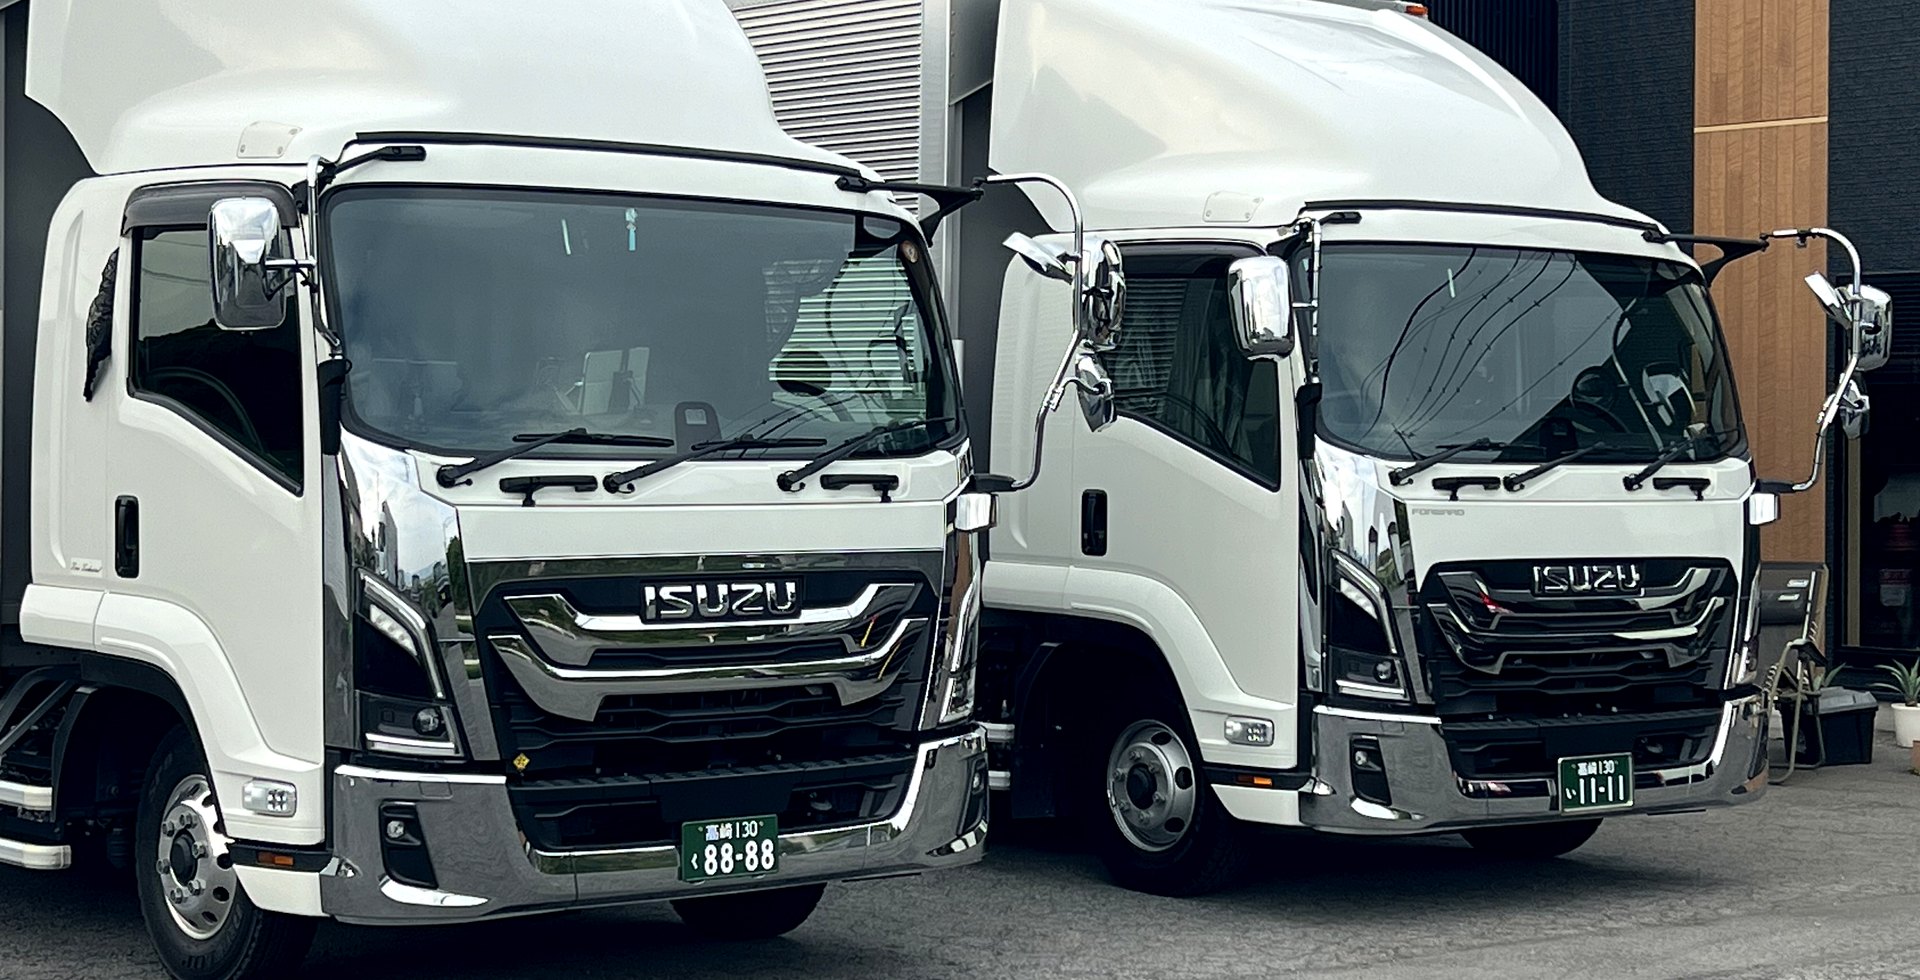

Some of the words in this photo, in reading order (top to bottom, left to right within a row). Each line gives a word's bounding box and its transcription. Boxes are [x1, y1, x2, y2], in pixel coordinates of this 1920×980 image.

[1533, 564, 1640, 594] ISUZU
[644, 582, 797, 619] ISUZU
[1598, 760, 1615, 775] 130
[1565, 787, 1577, 800] い
[735, 820, 759, 839] 130
[690, 852, 699, 870] く
[704, 838, 775, 876] 88-88
